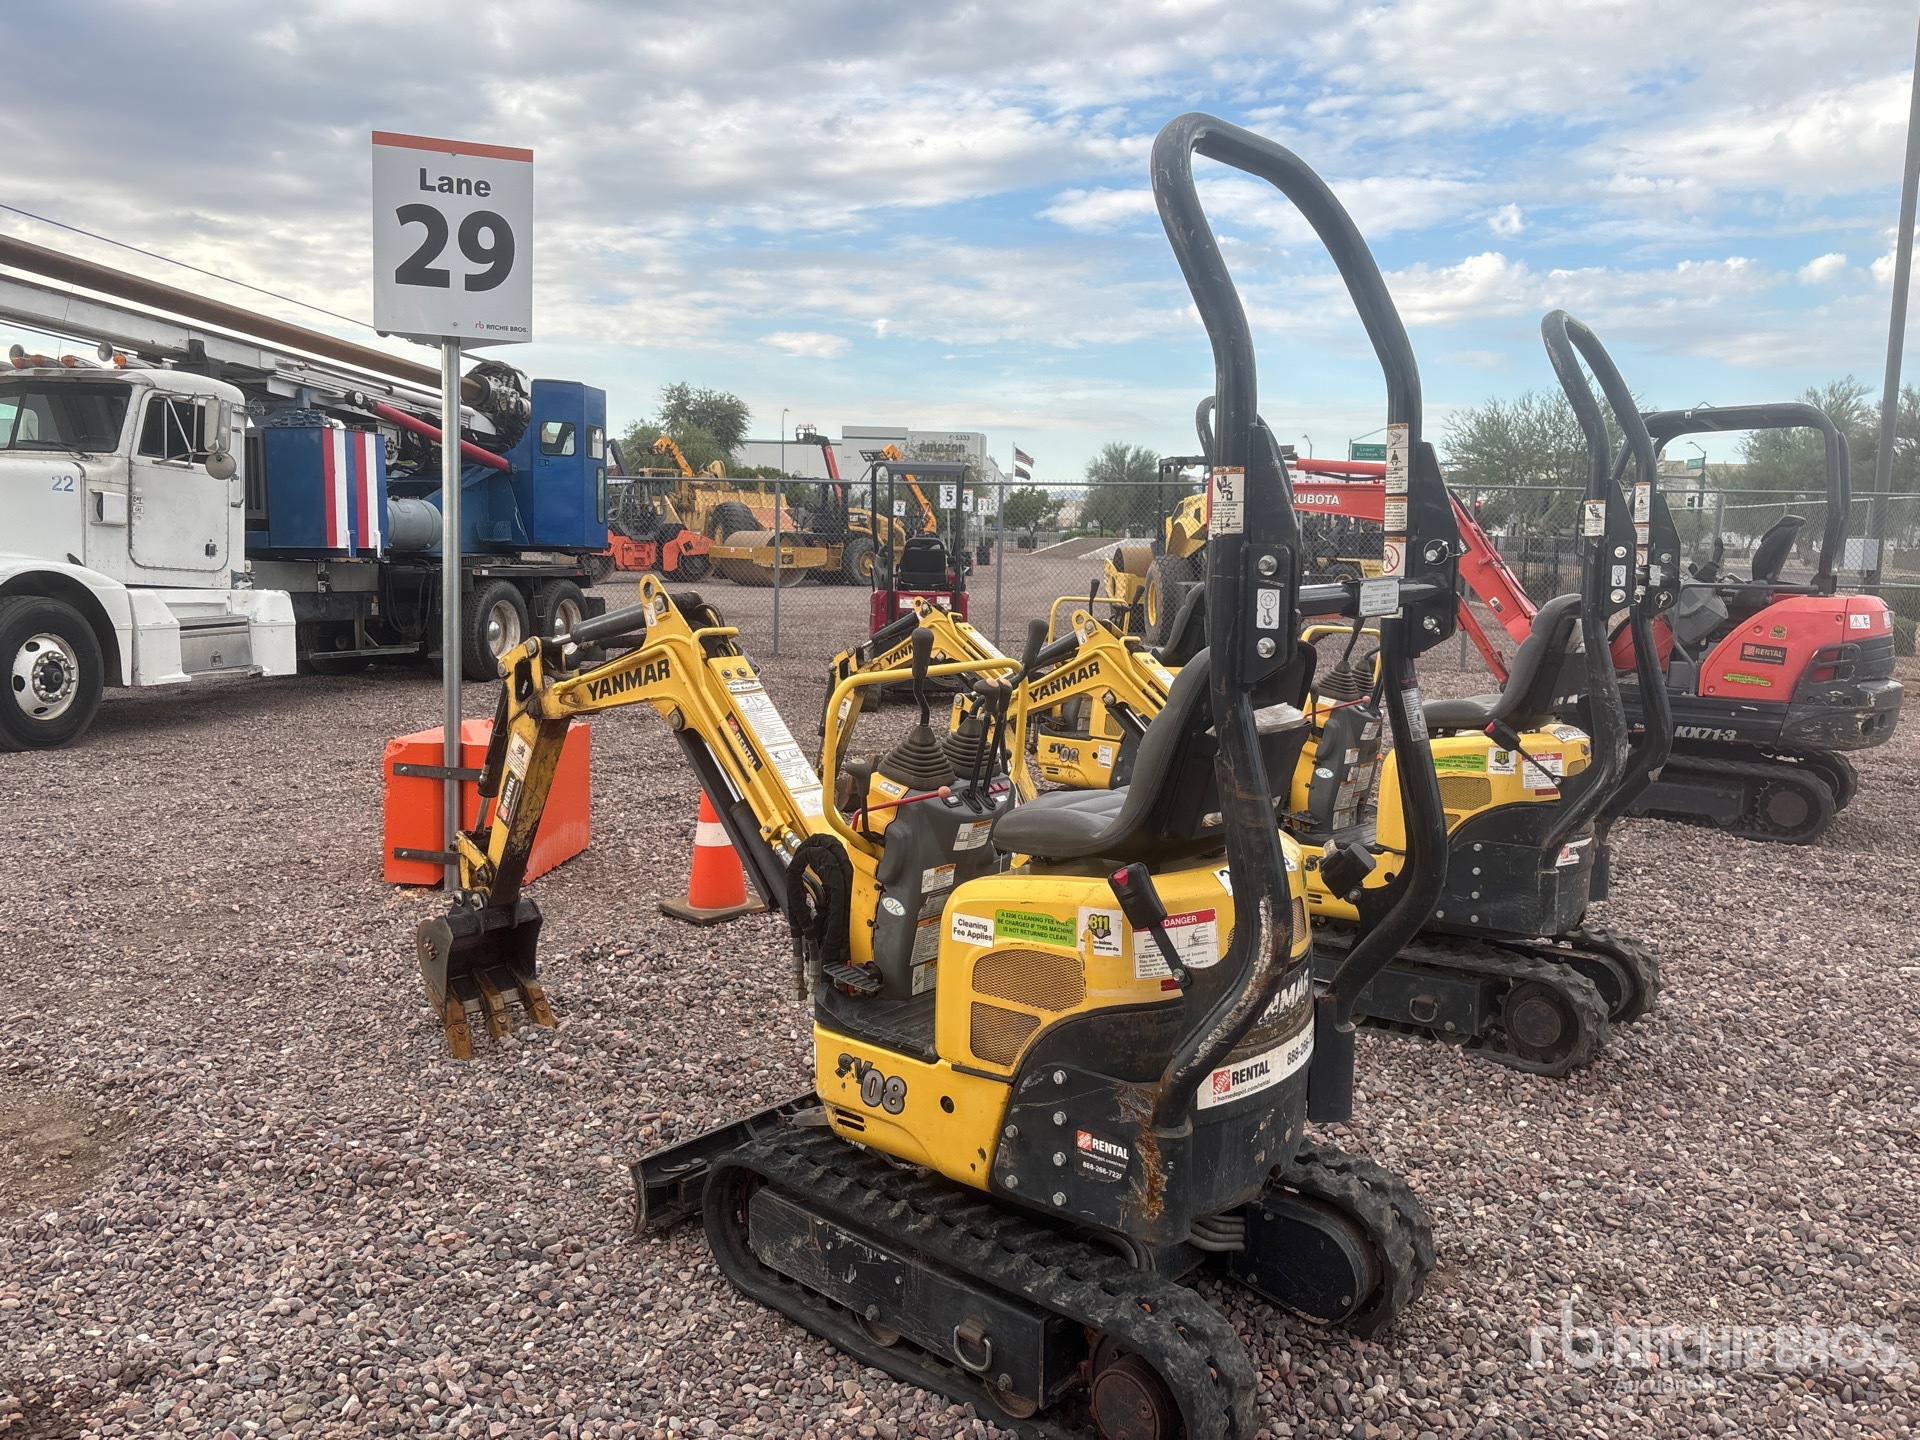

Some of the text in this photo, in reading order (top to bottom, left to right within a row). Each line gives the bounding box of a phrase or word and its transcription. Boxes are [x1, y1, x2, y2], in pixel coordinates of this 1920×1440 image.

[419, 167, 491, 197] Lane
[395, 203, 515, 292] 29
[486, 323, 509, 332] RITCHIE
[919, 441, 966, 453] amazon
[51, 474, 74, 492] 22
[945, 490, 953, 502] 5
[1293, 493, 1340, 506] KUBOTA
[1754, 647, 1783, 658] RENTAL
[586, 658, 671, 702] YANMAR
[1028, 661, 1101, 703] YANMAR
[1674, 725, 1738, 741] KX71-3
[1048, 742, 1080, 763] SV08
[1495, 751, 1508, 760] 811
[1316, 768, 1332, 778] OK
[502, 776, 516, 808] RENTAL
[885, 898, 902, 916] OK
[957, 918, 988, 933] Cleaning
[1005, 919, 1030, 928] CHARGED
[1049, 926, 1074, 935] MACHINE
[1017, 914, 1043, 923] CLEANING
[1044, 917, 1055, 925] FEE
[1088, 913, 1111, 931] 811
[1163, 915, 1197, 927] DANGER
[953, 926, 993, 942] Fee Applies
[1020, 928, 1049, 939] RETURNED
[1048, 933, 1068, 941] CLEAN
[1231, 1060, 1271, 1087] RENTAL
[834, 1052, 908, 1116] SV08
[1217, 1077, 1271, 1101] homedepot.com/rental
[1091, 1137, 1130, 1161] RENTAL
